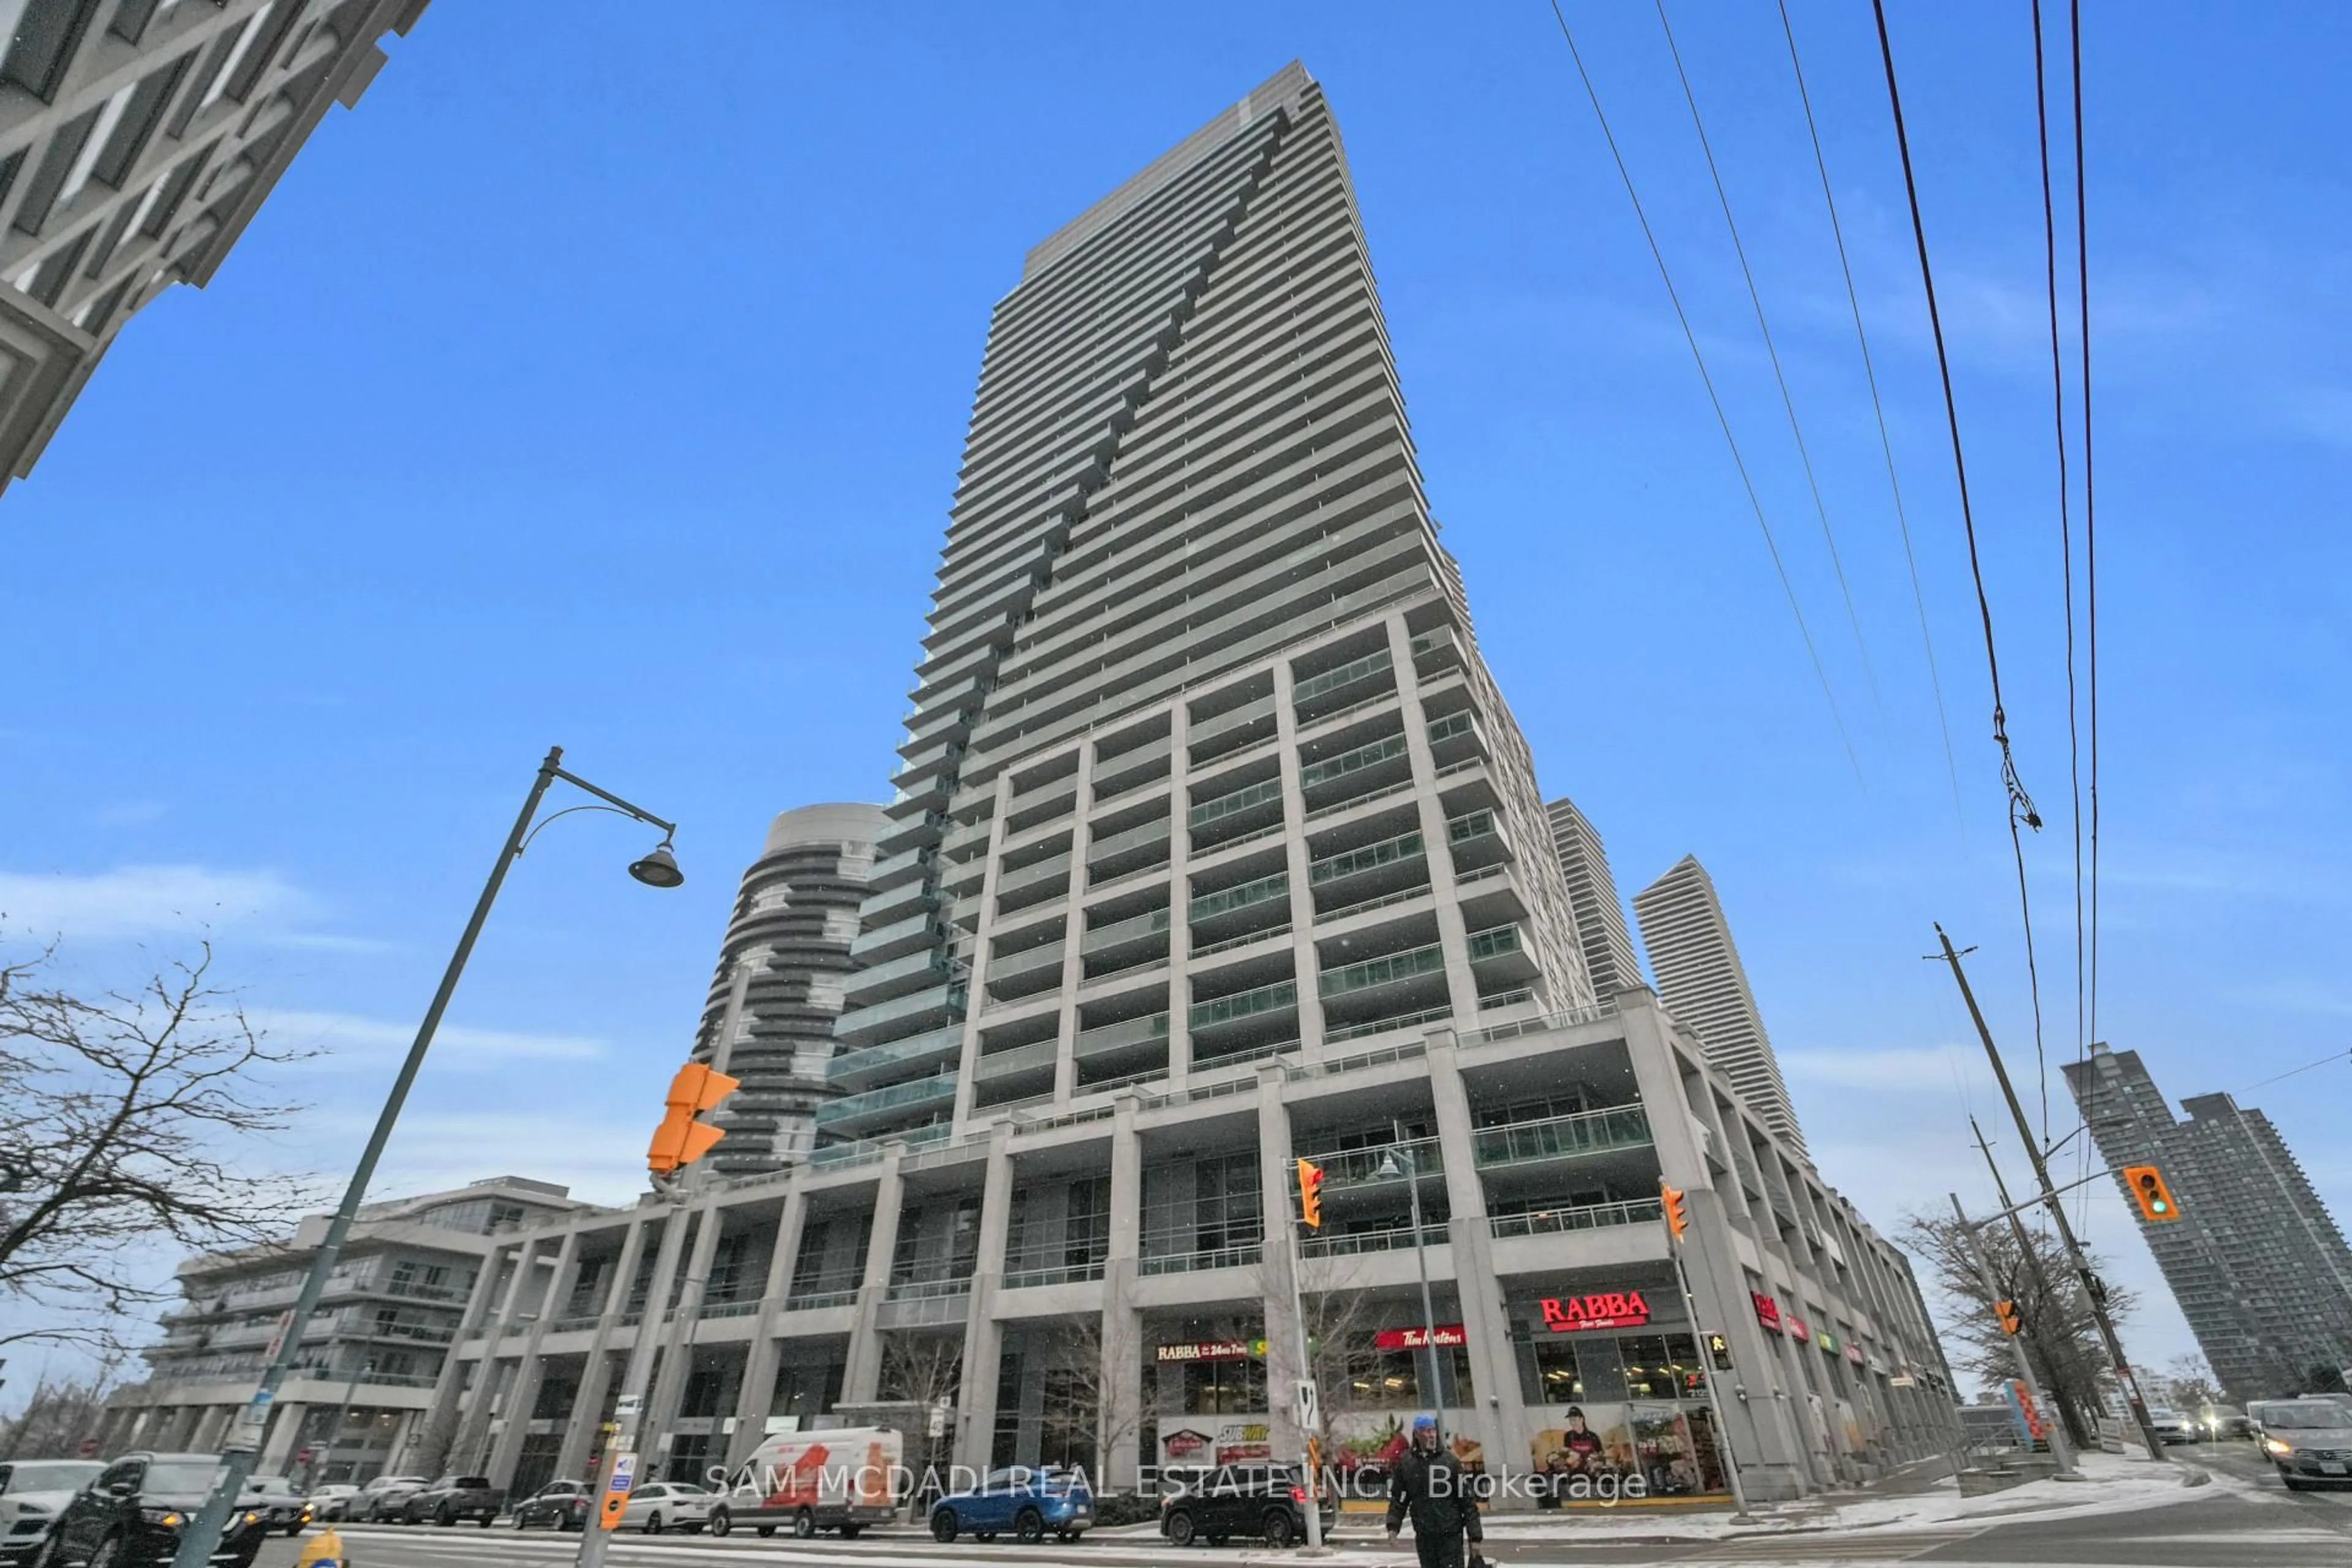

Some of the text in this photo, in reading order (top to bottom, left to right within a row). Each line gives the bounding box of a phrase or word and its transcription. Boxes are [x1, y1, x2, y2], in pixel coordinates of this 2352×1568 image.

[1540, 1290, 1649, 1323] RABBA
[1403, 1330, 1422, 1346] Tim
[1157, 1344, 1201, 1360] RABBA
[1218, 1425, 1268, 1442] SUBWAY
